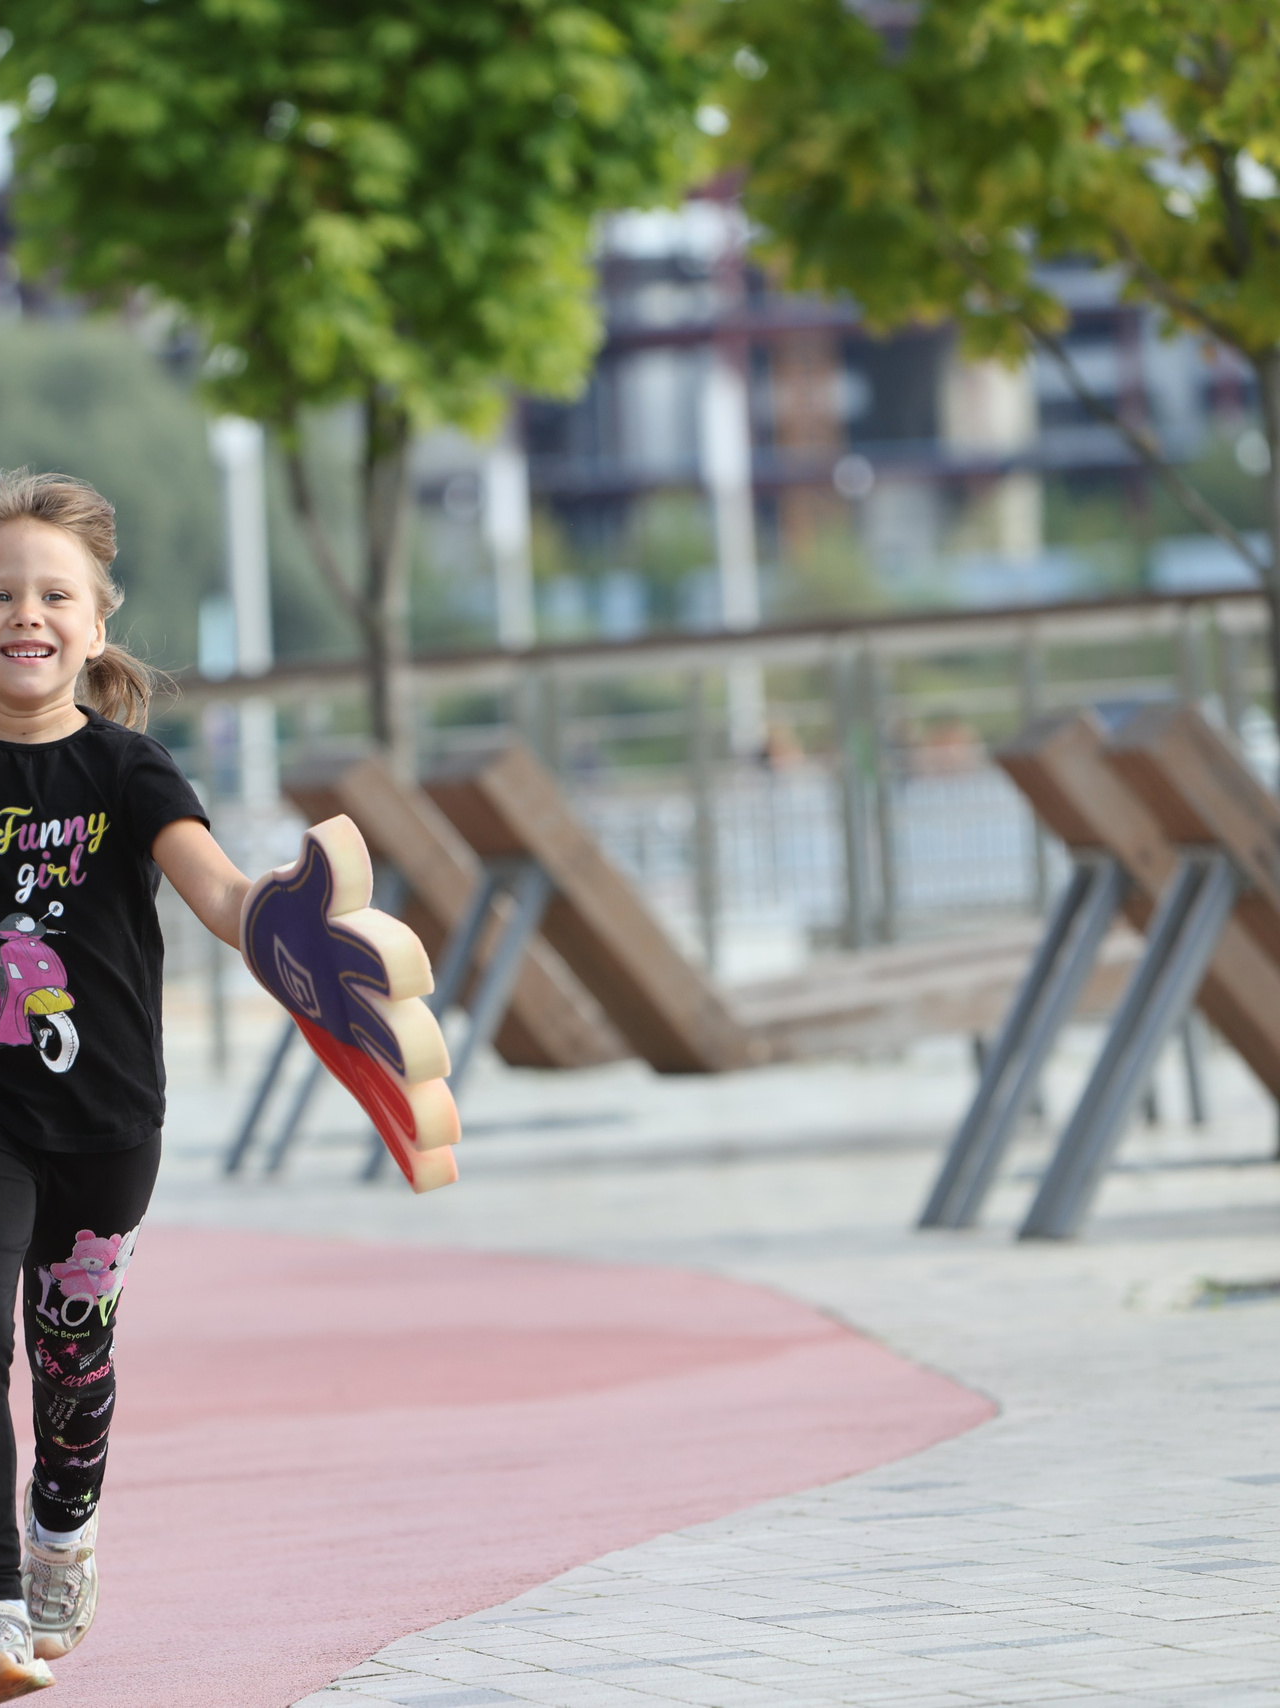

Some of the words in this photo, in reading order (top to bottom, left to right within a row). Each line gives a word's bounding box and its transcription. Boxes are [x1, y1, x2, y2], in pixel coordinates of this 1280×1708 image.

[15, 843, 87, 903] girl
[60, 1329, 90, 1341] Beyond
[36, 1338, 63, 1378] LOVE
